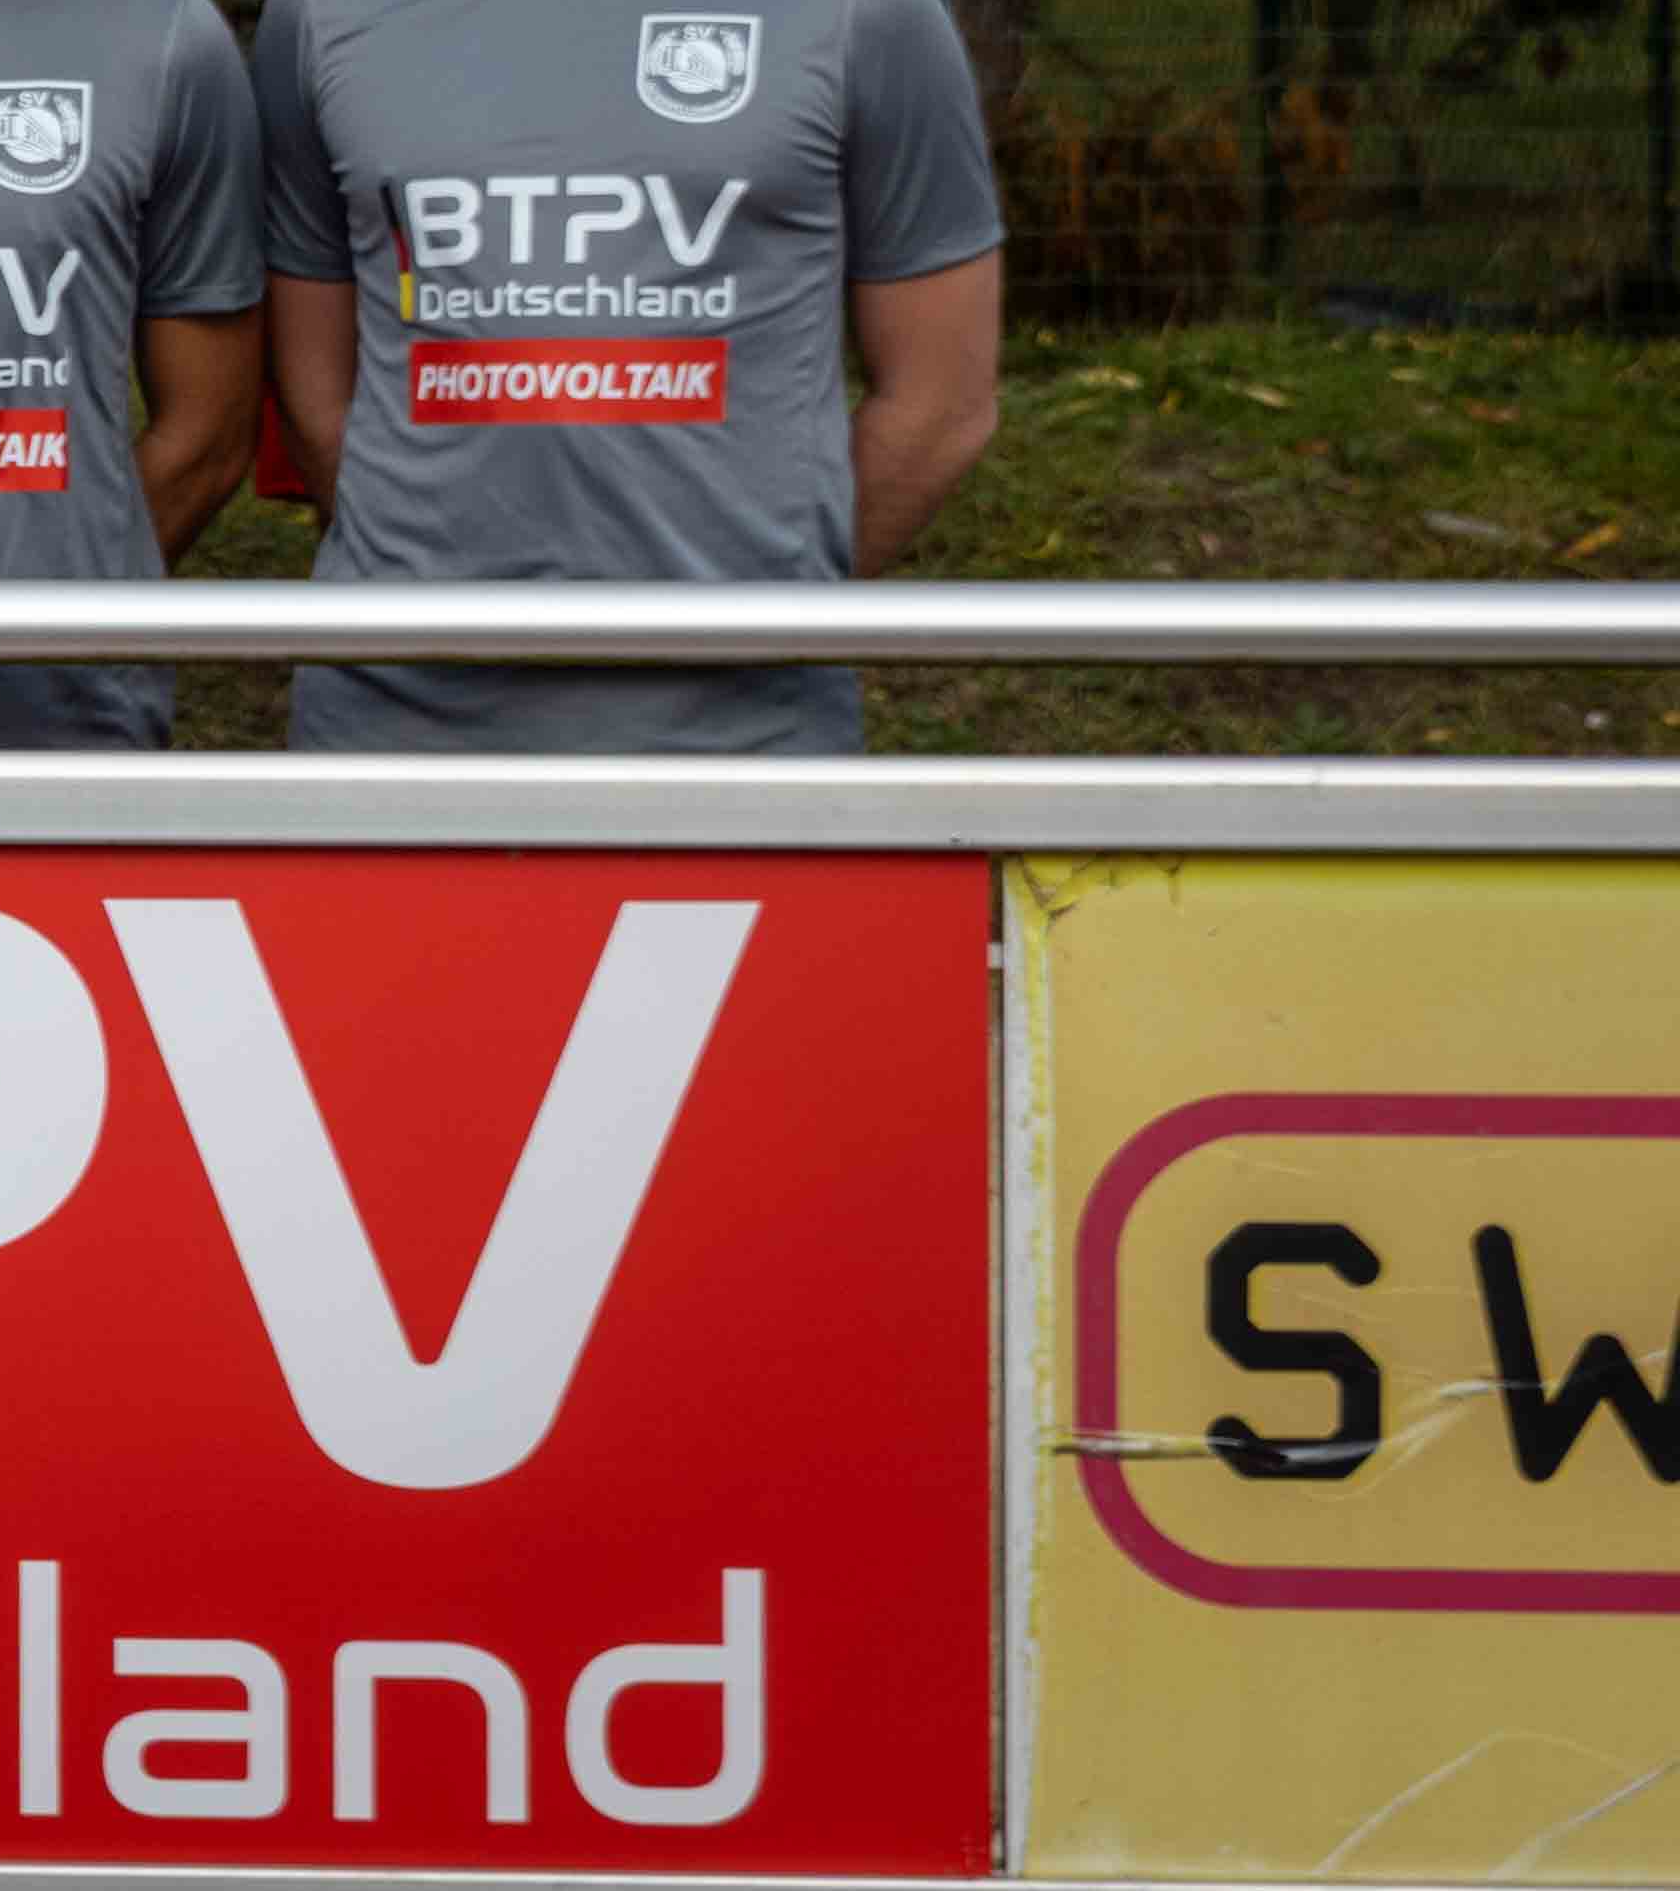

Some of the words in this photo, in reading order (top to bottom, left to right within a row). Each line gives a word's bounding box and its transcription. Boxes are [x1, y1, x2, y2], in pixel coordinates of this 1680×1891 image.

[18, 90, 48, 108] SV
[406, 175, 747, 266] BTPV
[420, 274, 734, 321] Deutschland
[417, 362, 714, 400] PHOTOVOLTAIK
